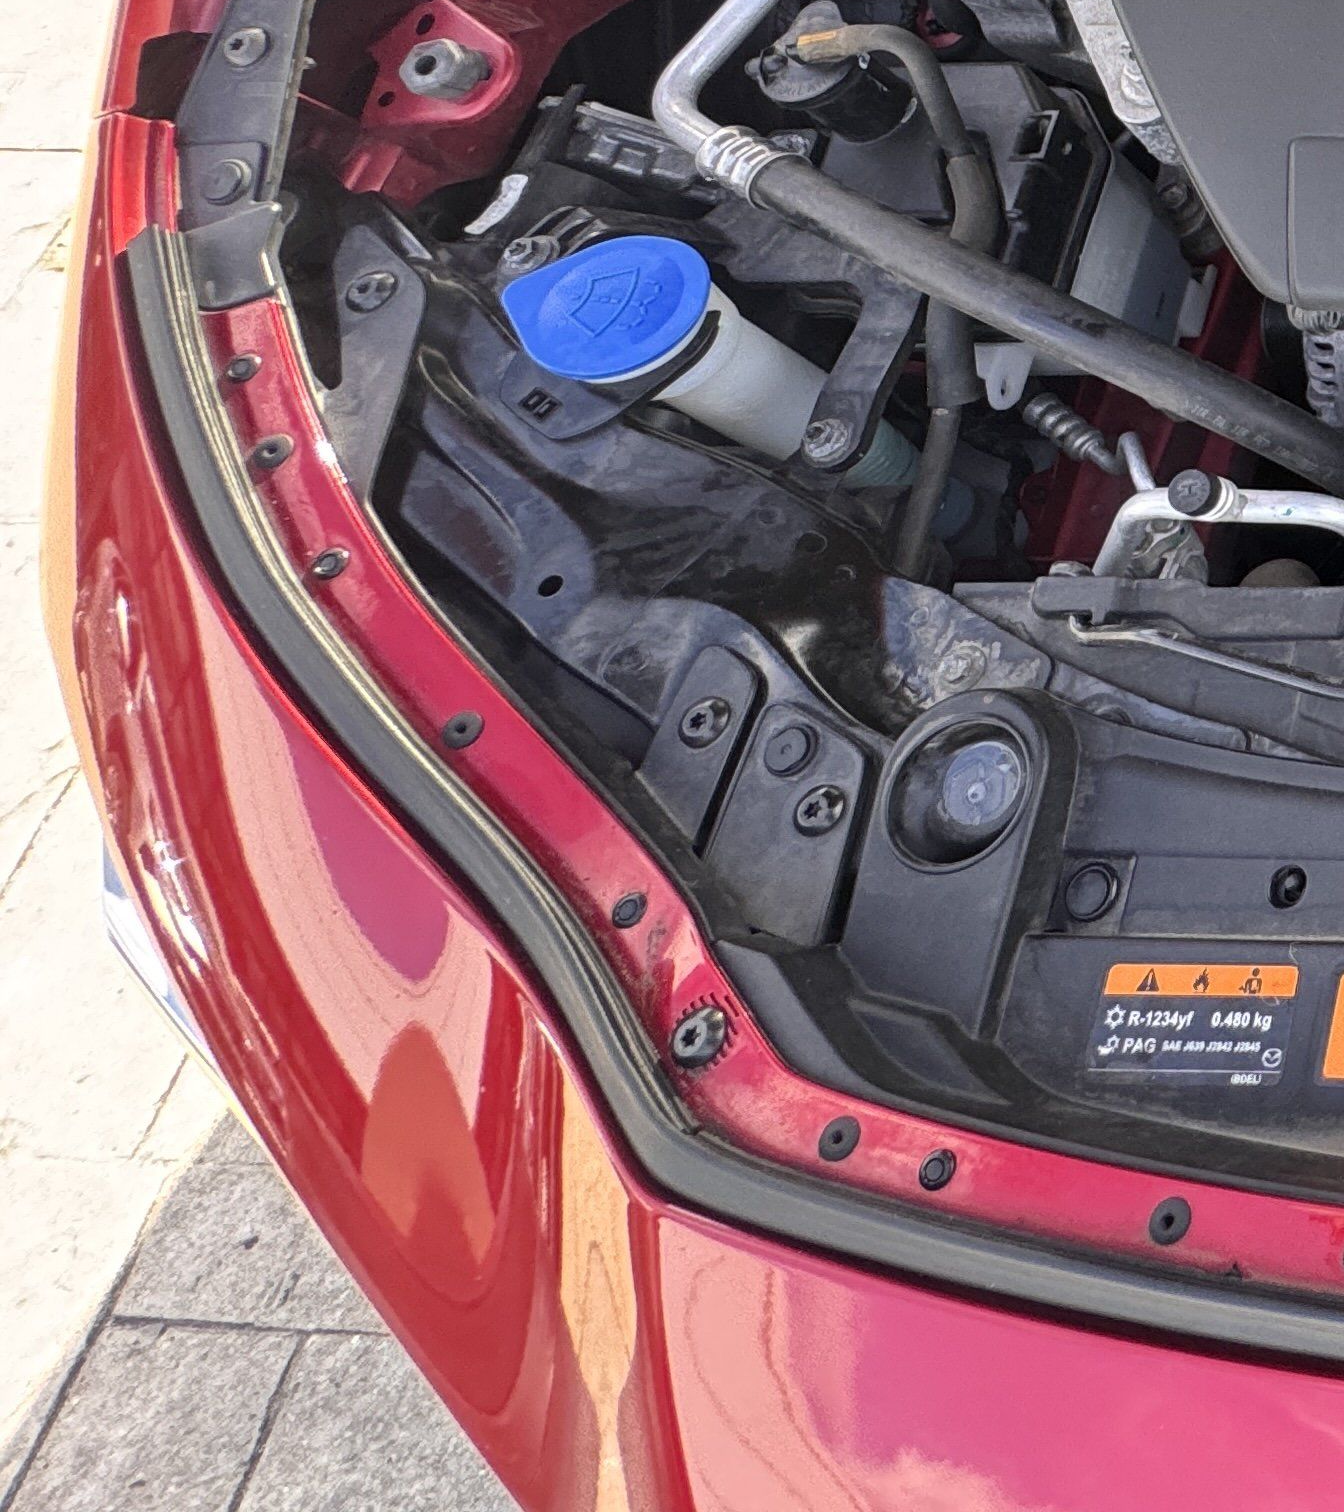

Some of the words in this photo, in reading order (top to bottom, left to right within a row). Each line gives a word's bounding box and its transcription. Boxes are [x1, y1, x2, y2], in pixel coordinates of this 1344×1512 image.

[1127, 1010, 1194, 1031] R-1234yf
[1211, 1011, 1250, 1028] 0.480
[1253, 1012, 1273, 1032] kg
[1122, 1038, 1157, 1054] PAG
